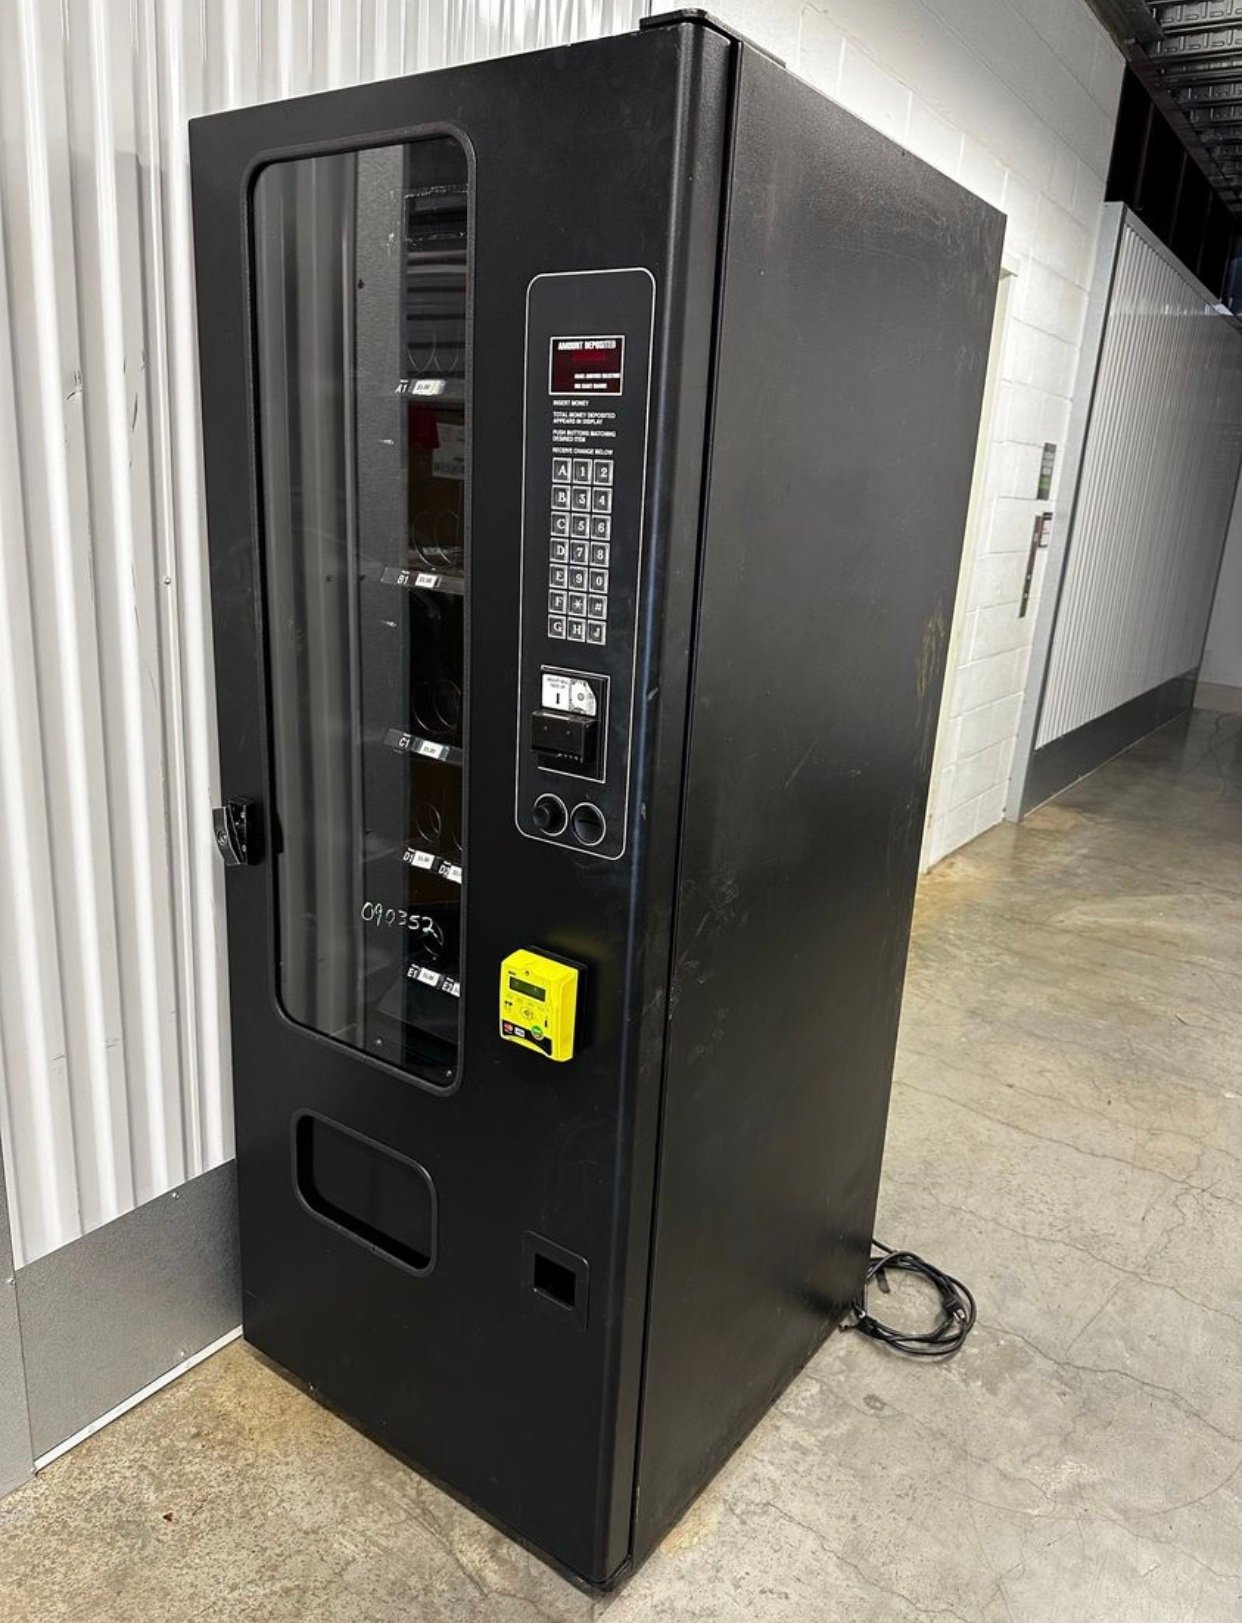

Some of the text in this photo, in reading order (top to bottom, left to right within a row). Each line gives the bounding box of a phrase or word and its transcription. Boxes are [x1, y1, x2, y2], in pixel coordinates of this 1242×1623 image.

[558, 341, 583, 350] AMOUNT
[395, 383, 407, 393] A1
[397, 574, 408, 585] B1
[399, 737, 410, 748] C1
[403, 851, 413, 863] D1
[361, 901, 438, 938] 090352
